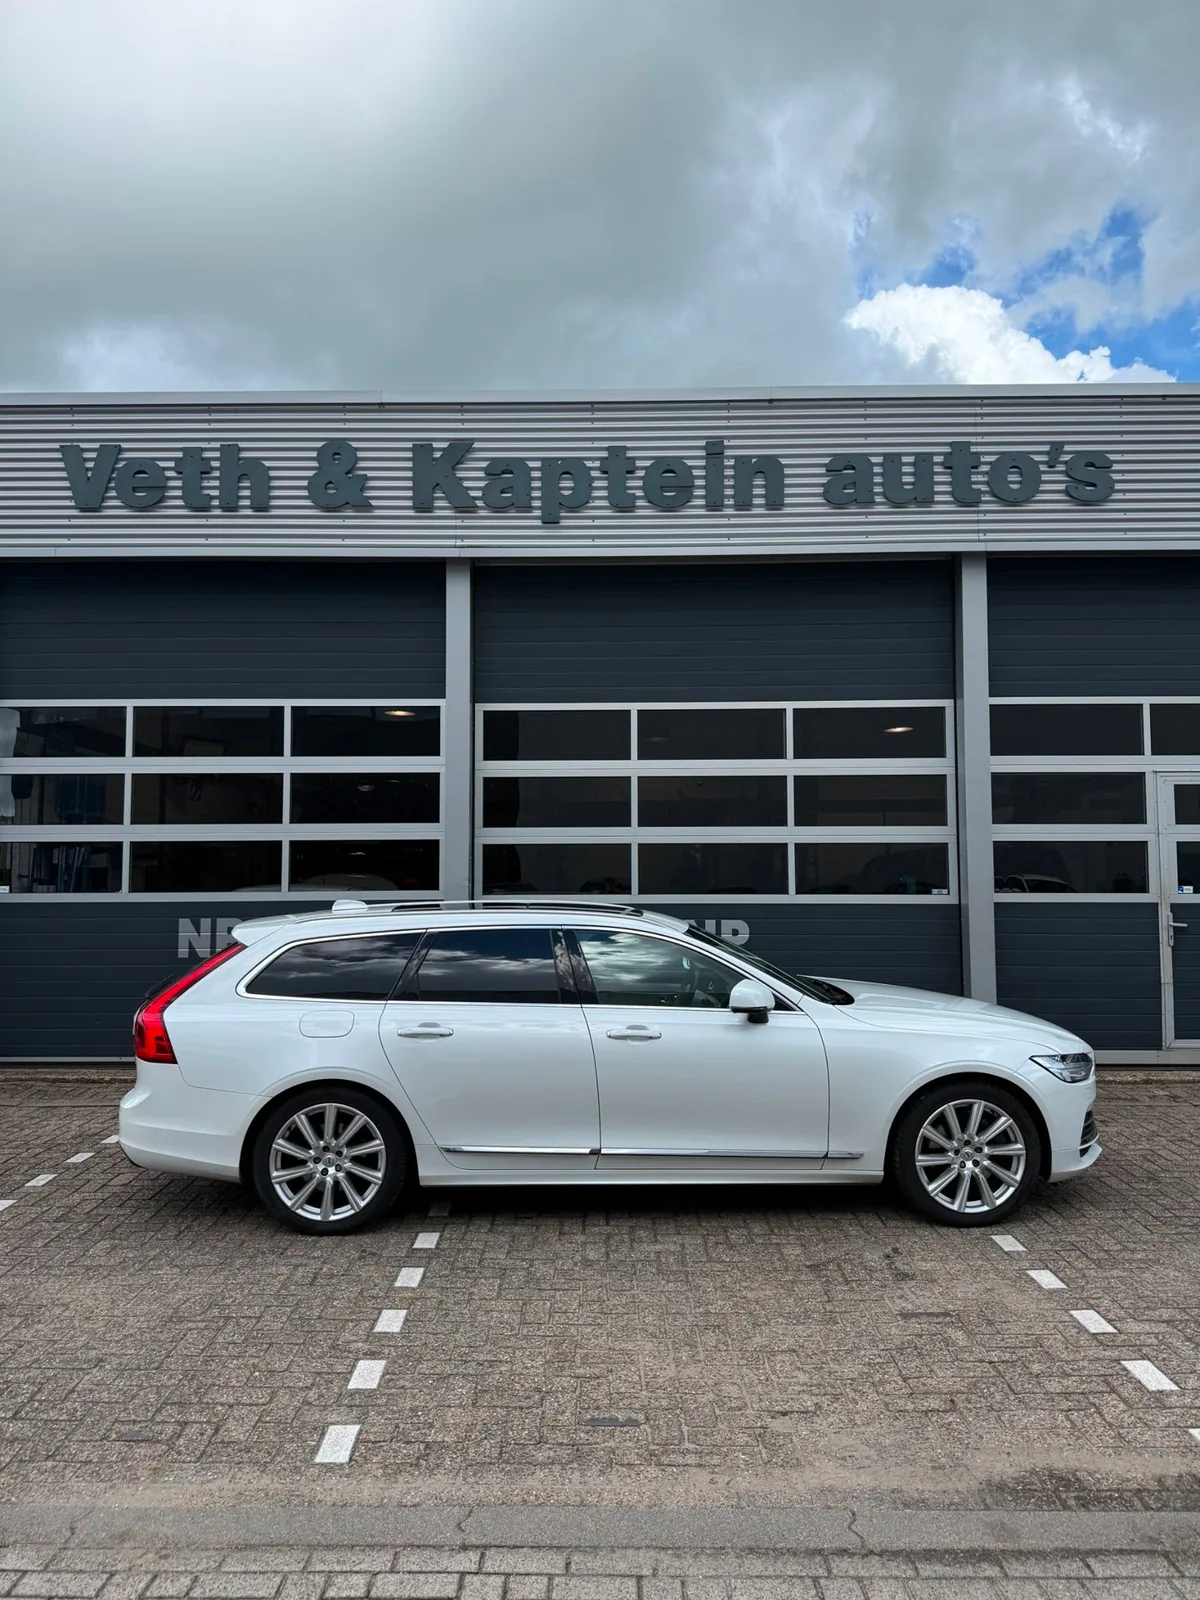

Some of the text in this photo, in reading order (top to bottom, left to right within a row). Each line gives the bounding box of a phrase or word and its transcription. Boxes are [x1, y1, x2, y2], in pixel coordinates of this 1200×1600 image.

[60, 440, 1115, 524] Veth & Kaptein auto's
